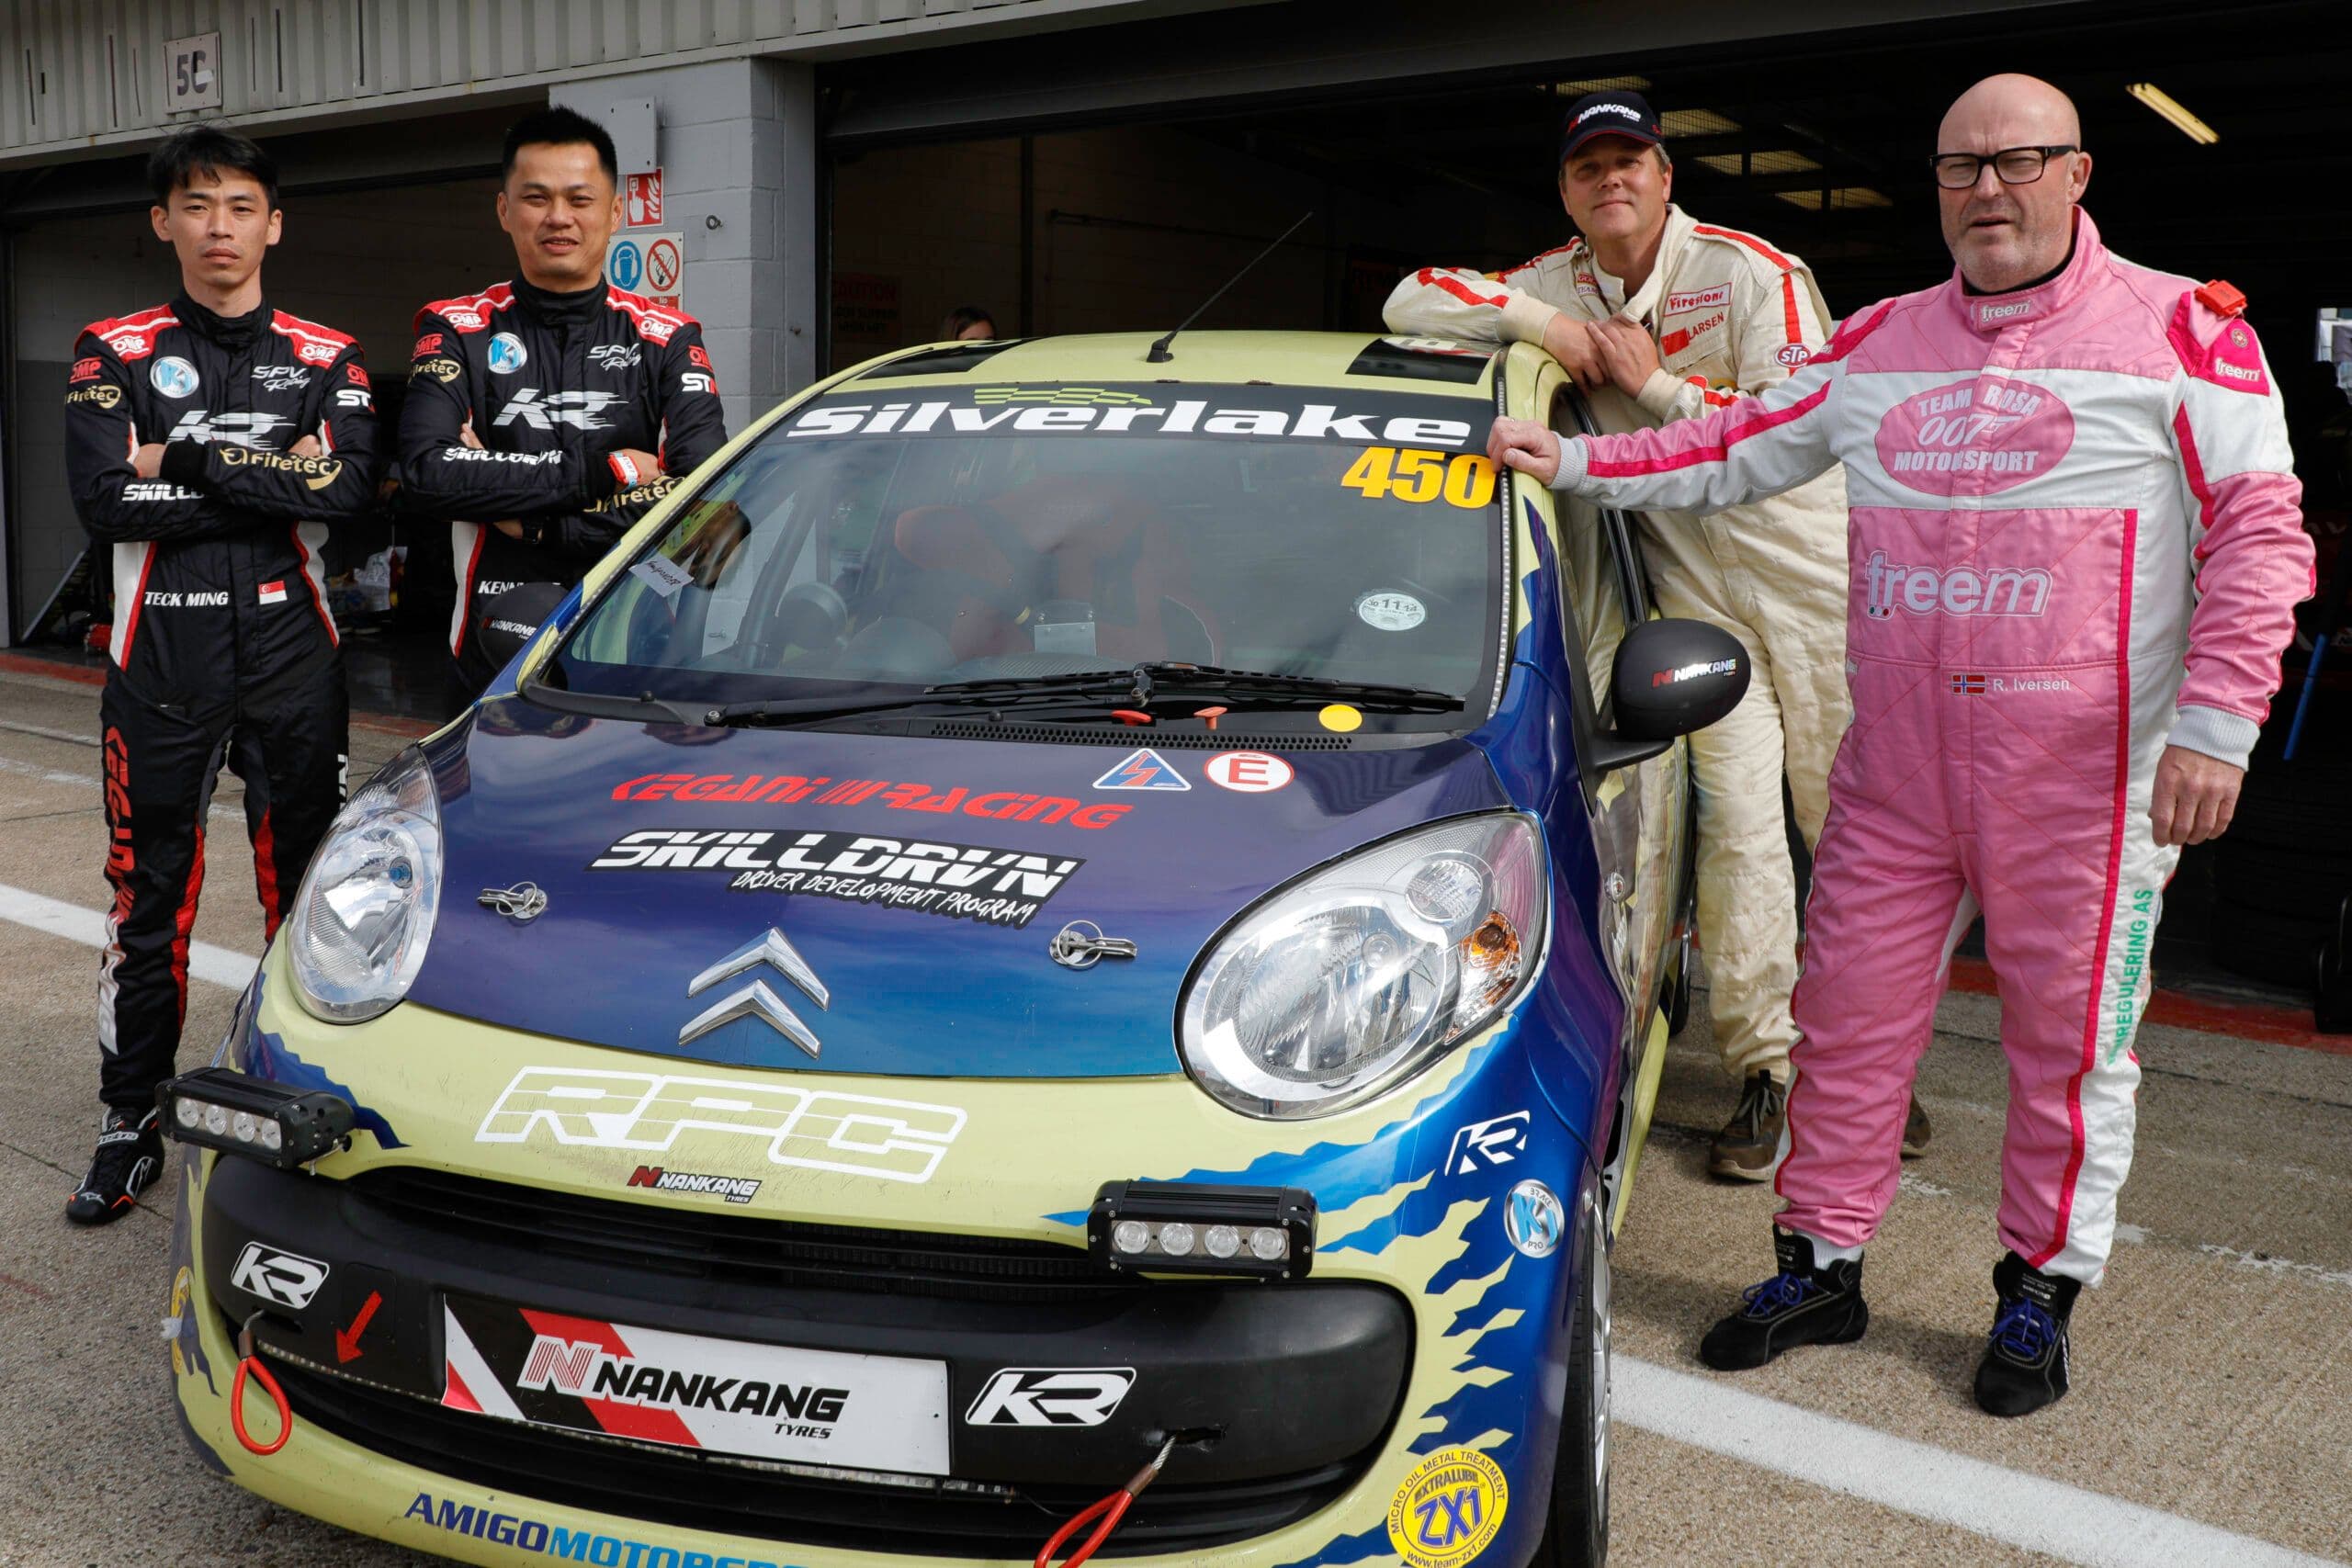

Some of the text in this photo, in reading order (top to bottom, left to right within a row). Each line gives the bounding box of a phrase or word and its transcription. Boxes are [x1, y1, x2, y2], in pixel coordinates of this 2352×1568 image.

[640, 320, 673, 336] OMP
[1687, 311, 1724, 341] LARSEN
[1781, 344, 1809, 364] STP
[1918, 388, 1973, 416] TEAM
[787, 400, 1471, 446] Silverlake
[1918, 414, 1996, 447] 007
[1340, 446, 1497, 509] 450
[1867, 551, 2051, 615] freem
[144, 591, 229, 607] TECK MING
[1993, 678, 2069, 691] R. Iversen
[1227, 758, 1270, 786] E
[733, 870, 1037, 921] DRIVER DEVELOPMENT PROGRAM
[2132, 888, 2154, 913] AS
[474, 1065, 969, 1184] RPC
[656, 1172, 762, 1195] NANKANG
[1527, 1239, 1544, 1250] PRO
[233, 1245, 329, 1309] KR
[592, 1359, 850, 1423] NANKANG
[970, 1369, 1133, 1425] KR
[774, 1422, 833, 1439] TYRES
[1390, 1450, 1505, 1534] MICRO OIL METAL TREATMENT
[1415, 1486, 1483, 1549] ZX1
